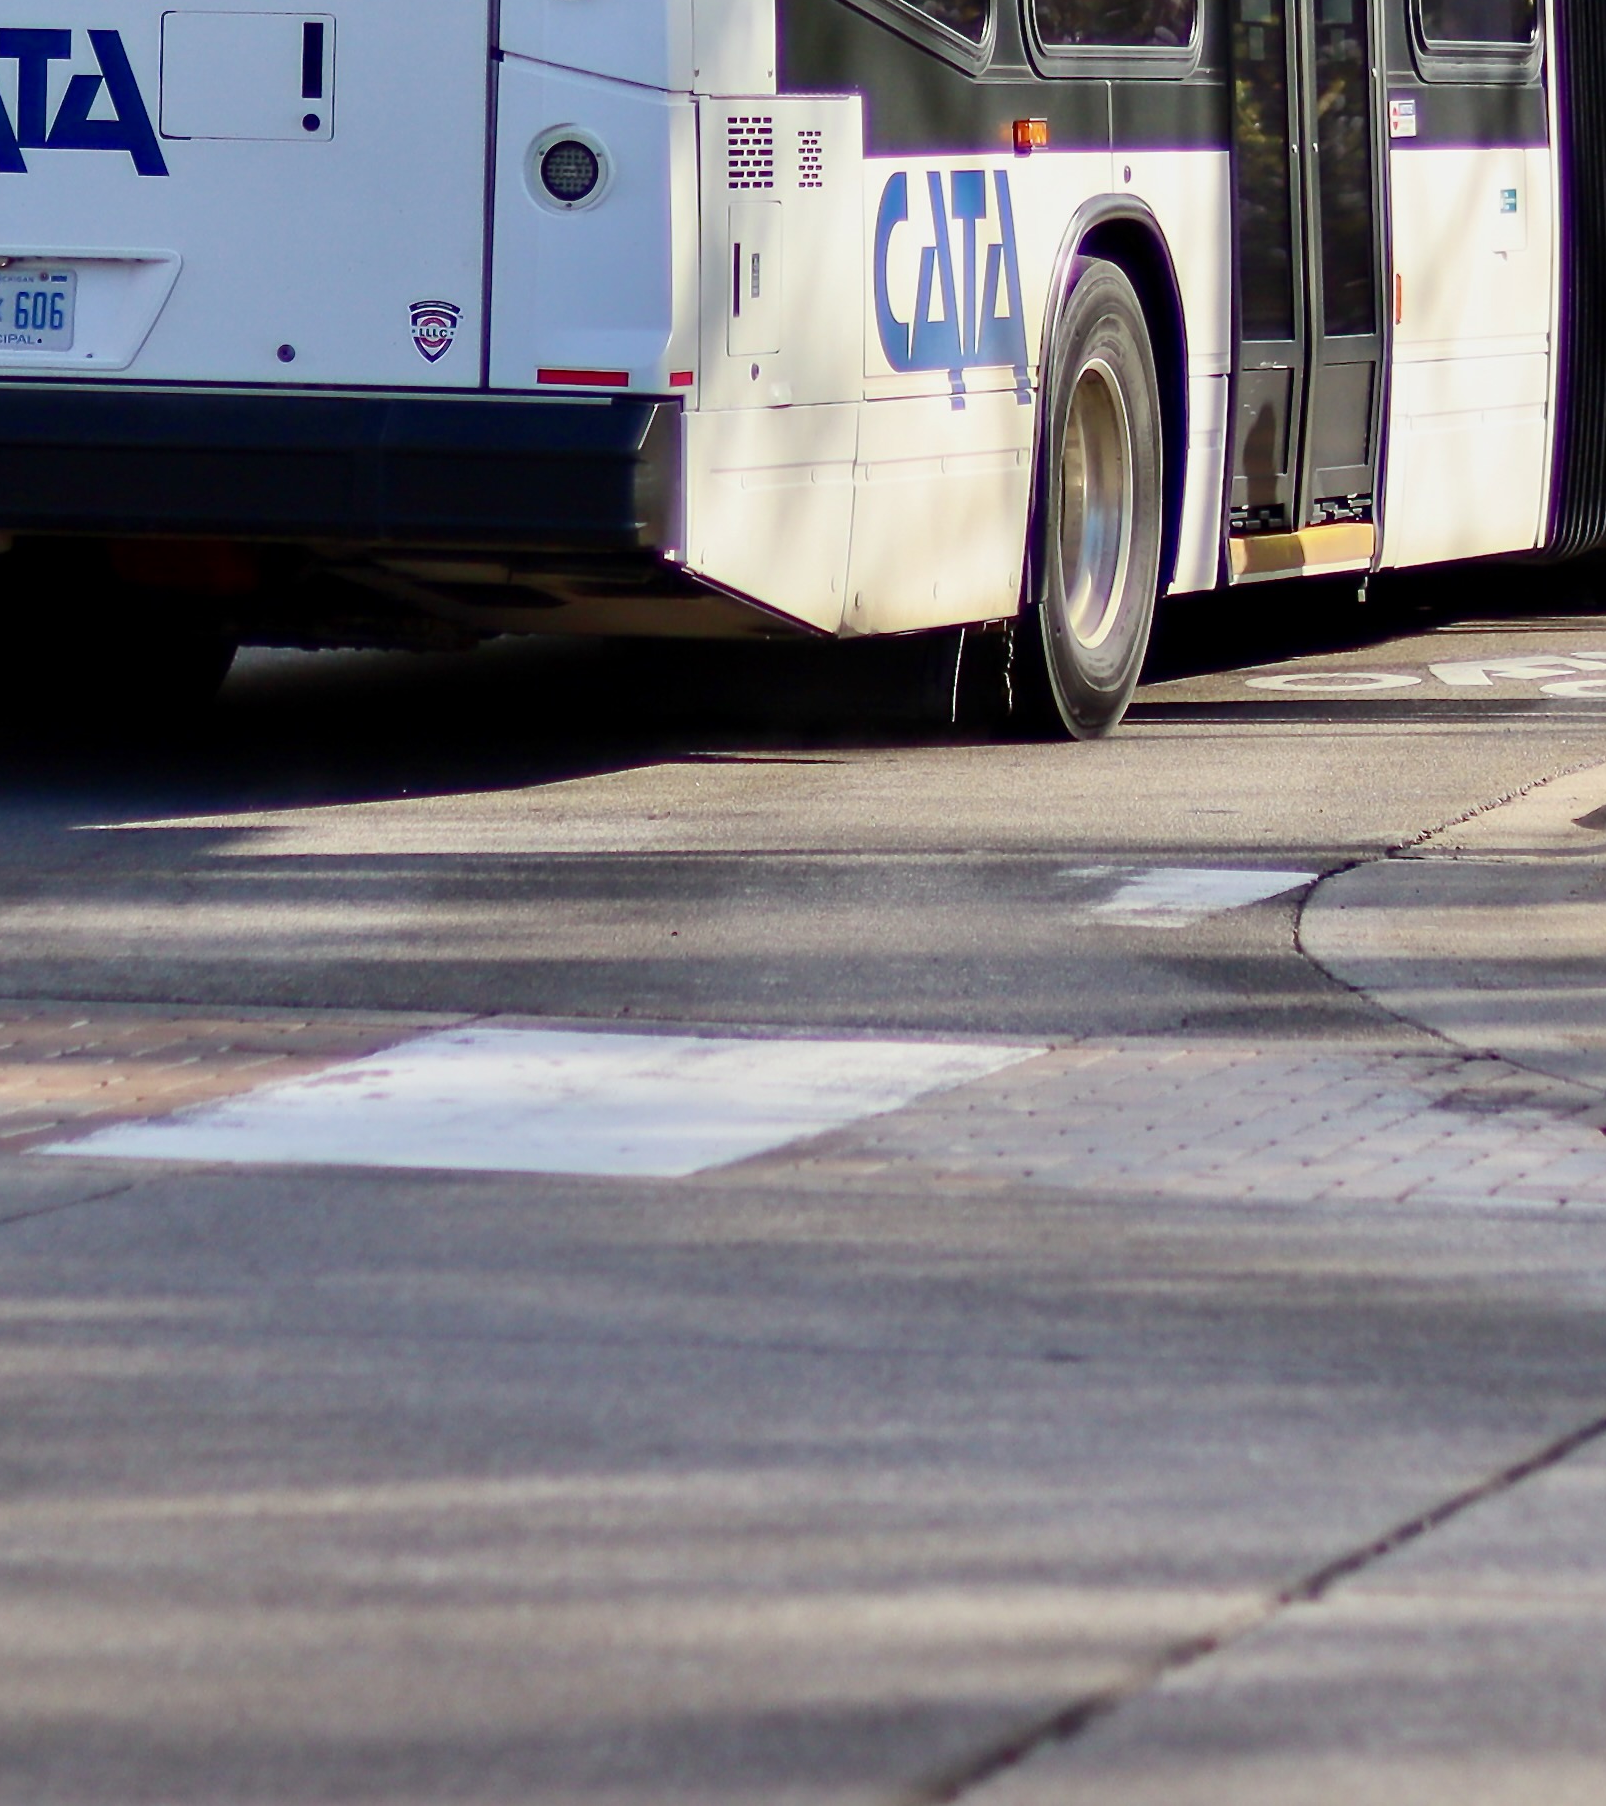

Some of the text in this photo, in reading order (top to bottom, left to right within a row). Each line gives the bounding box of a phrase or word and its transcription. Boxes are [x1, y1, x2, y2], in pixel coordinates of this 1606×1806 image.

[873, 169, 1032, 411] CATA
[14, 291, 66, 330] 606
[419, 328, 448, 338] LLLC
